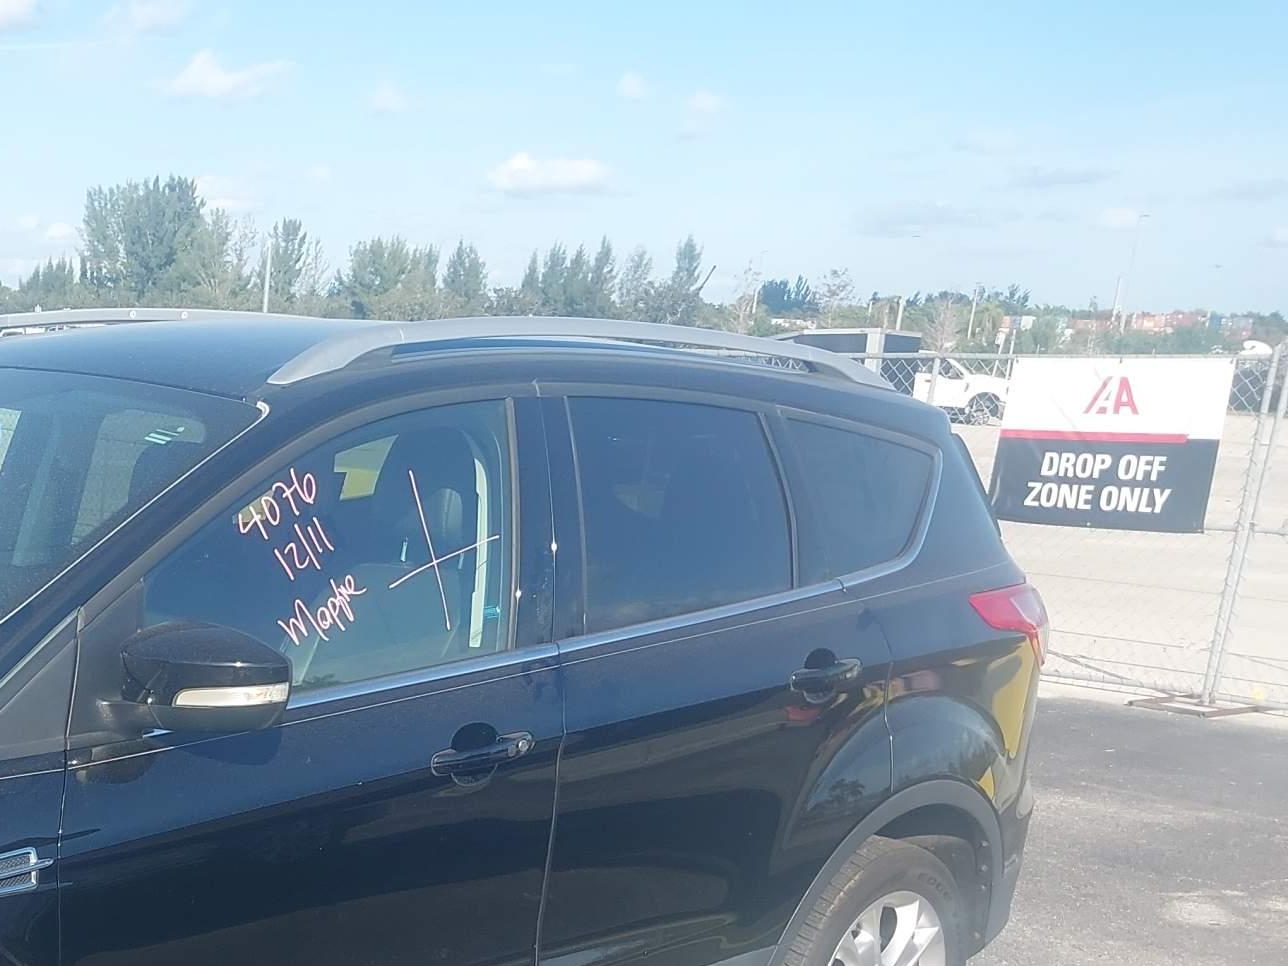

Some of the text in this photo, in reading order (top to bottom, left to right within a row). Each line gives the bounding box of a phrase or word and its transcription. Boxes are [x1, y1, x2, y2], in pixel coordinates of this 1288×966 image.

[1040, 451, 1168, 482] DROP OFF
[237, 467, 317, 540] 4076
[1023, 482, 1172, 513] ZONE ONLY
[273, 516, 335, 581] 12/11
